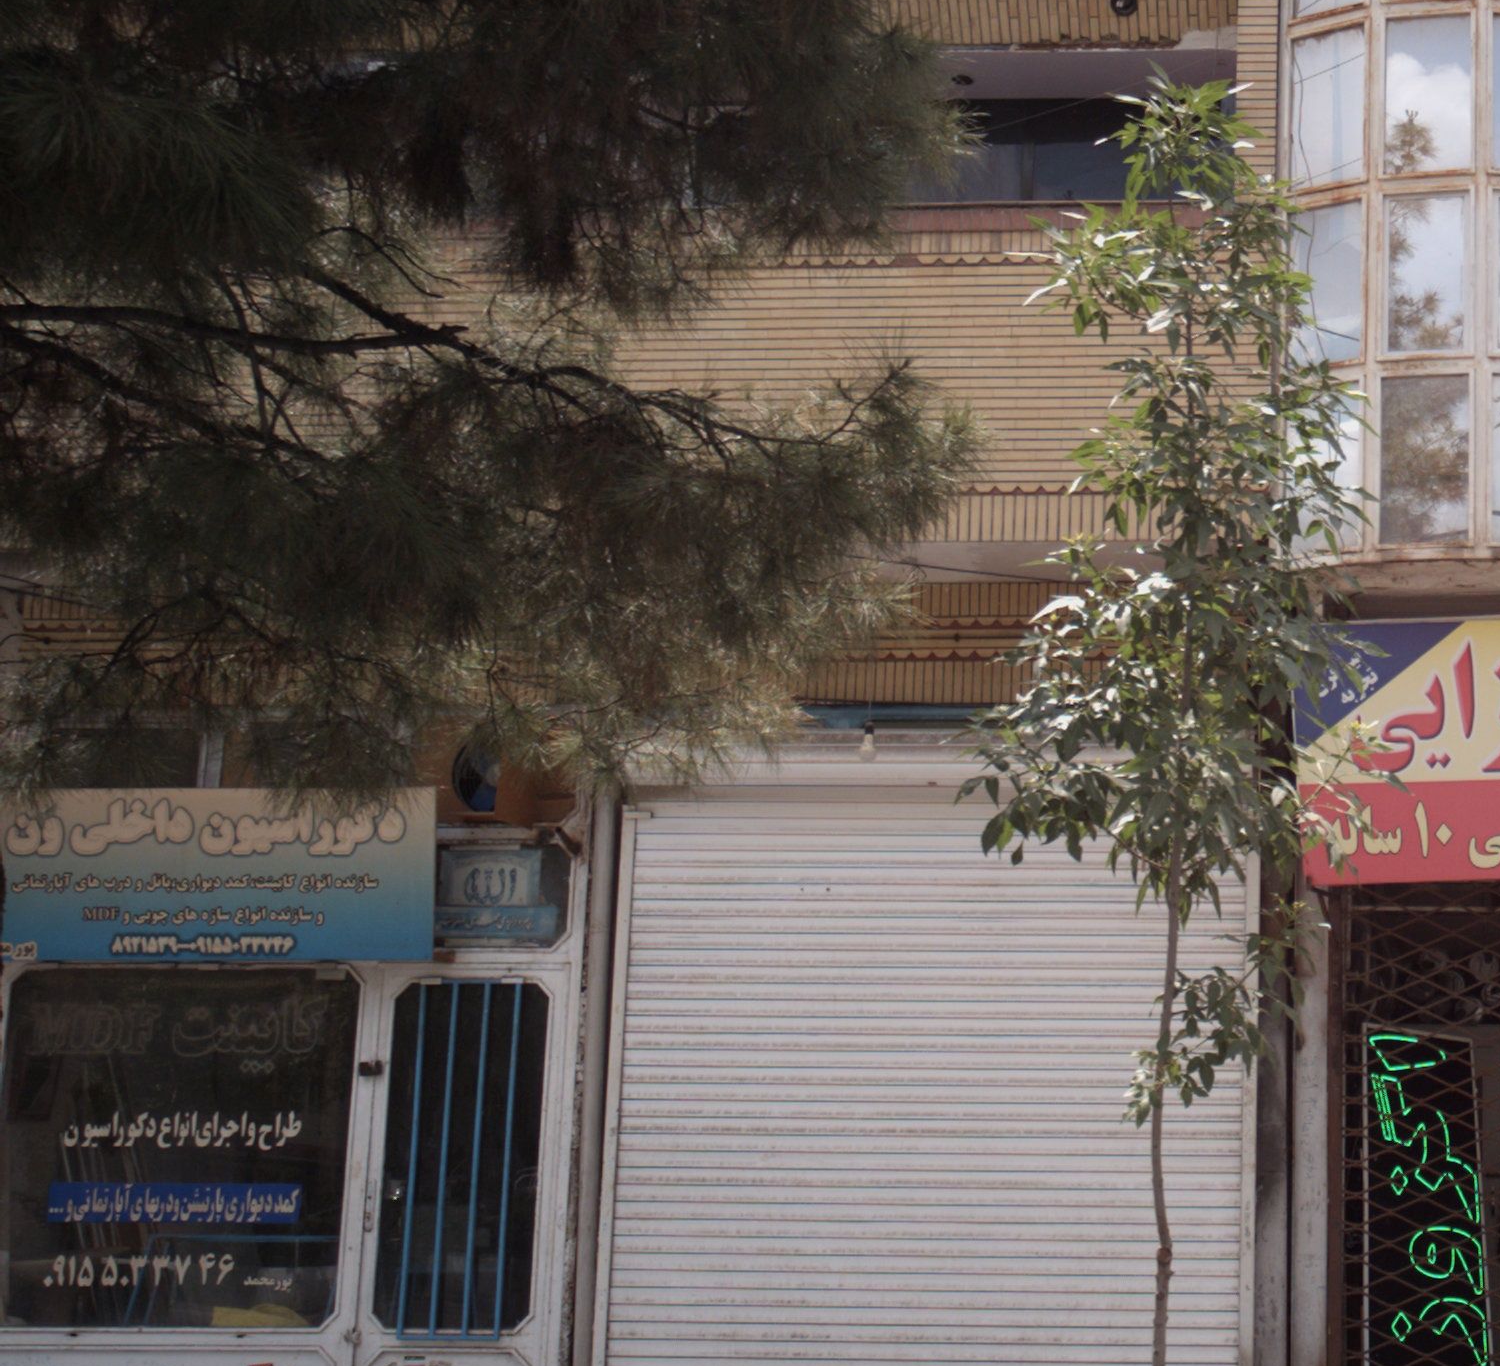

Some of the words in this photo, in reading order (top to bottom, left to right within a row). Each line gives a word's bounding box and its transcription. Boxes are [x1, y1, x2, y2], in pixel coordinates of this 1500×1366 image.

[70, 797, 194, 856] داخلی
[200, 798, 407, 856] دکوراسیون
[1415, 799, 1453, 858] ۱۰
[299, 874, 331, 893] انواع
[334, 874, 379, 893] سازنده
[82, 906, 120, 922] MDF
[234, 906, 267, 925] انواع
[270, 906, 313, 925] سازنده
[156, 1111, 198, 1148] انواع
[258, 1110, 303, 1150] طراح
[274, 1188, 300, 1214] کمد
